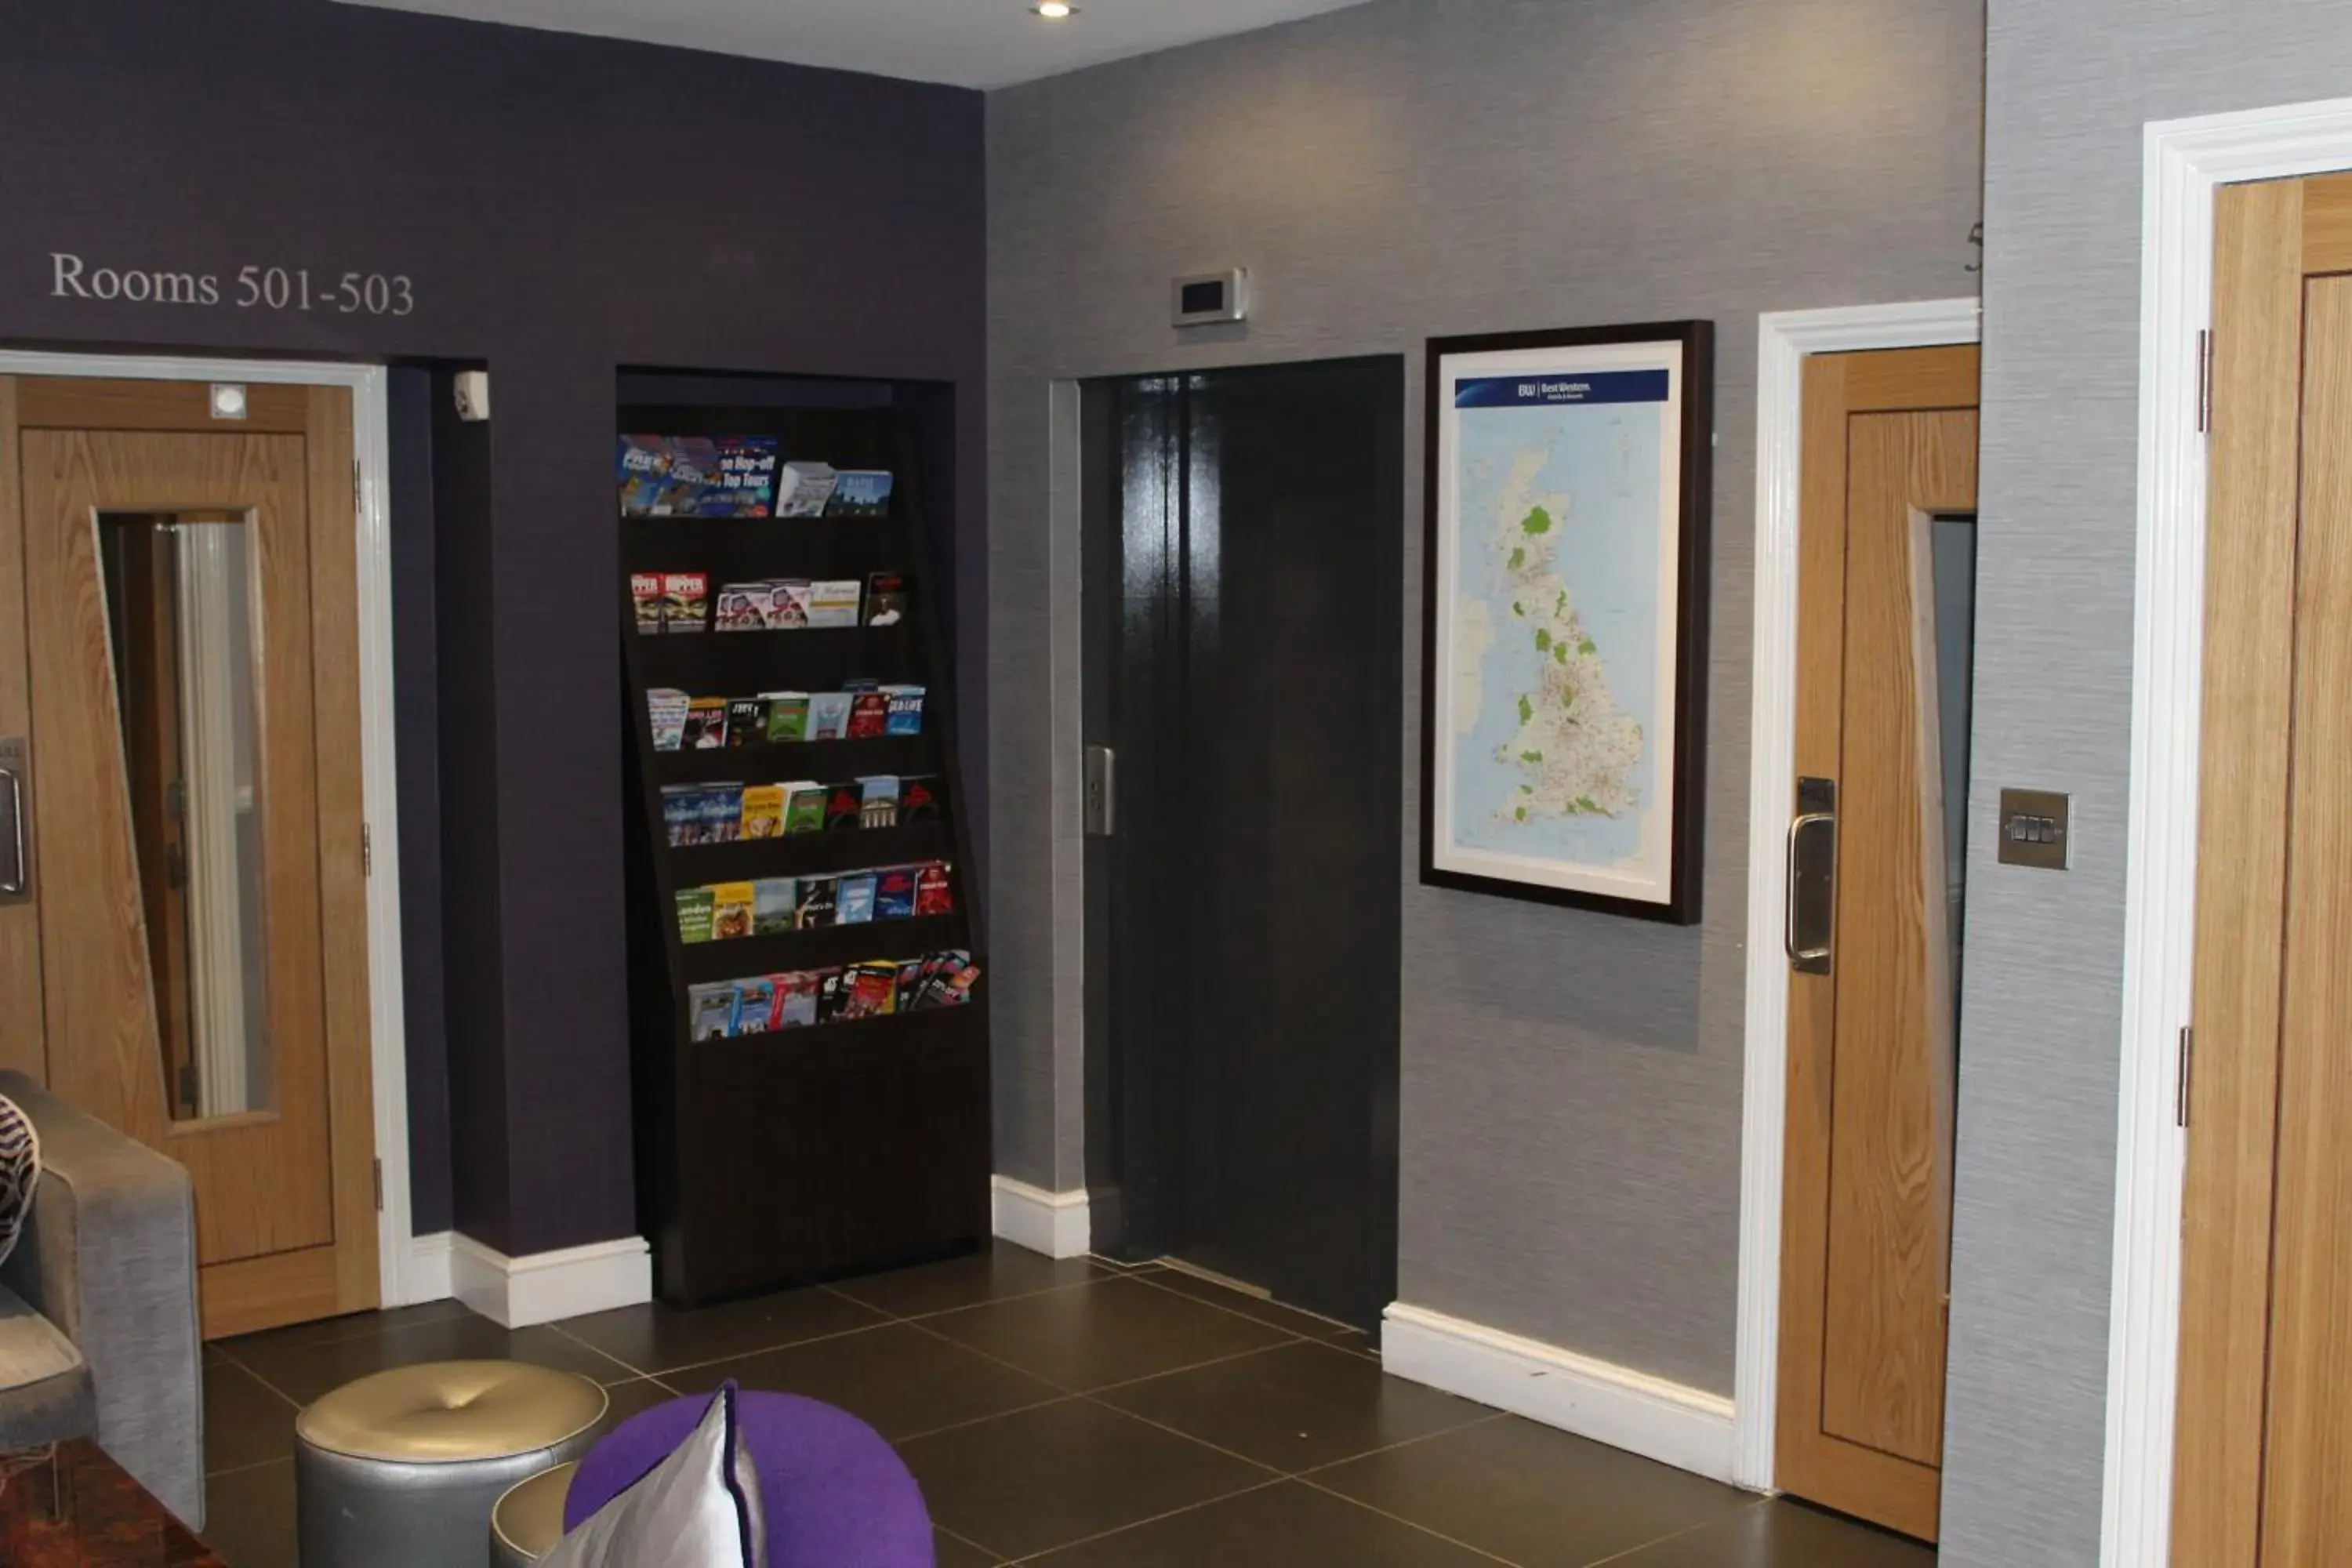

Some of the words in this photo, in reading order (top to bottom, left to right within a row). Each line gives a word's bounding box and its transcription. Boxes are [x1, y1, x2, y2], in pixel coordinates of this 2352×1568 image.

[49, 252, 220, 305] Rooms
[237, 265, 414, 315] 501-503
[1541, 383, 1559, 393] Best
[1559, 382, 1591, 392] Western
